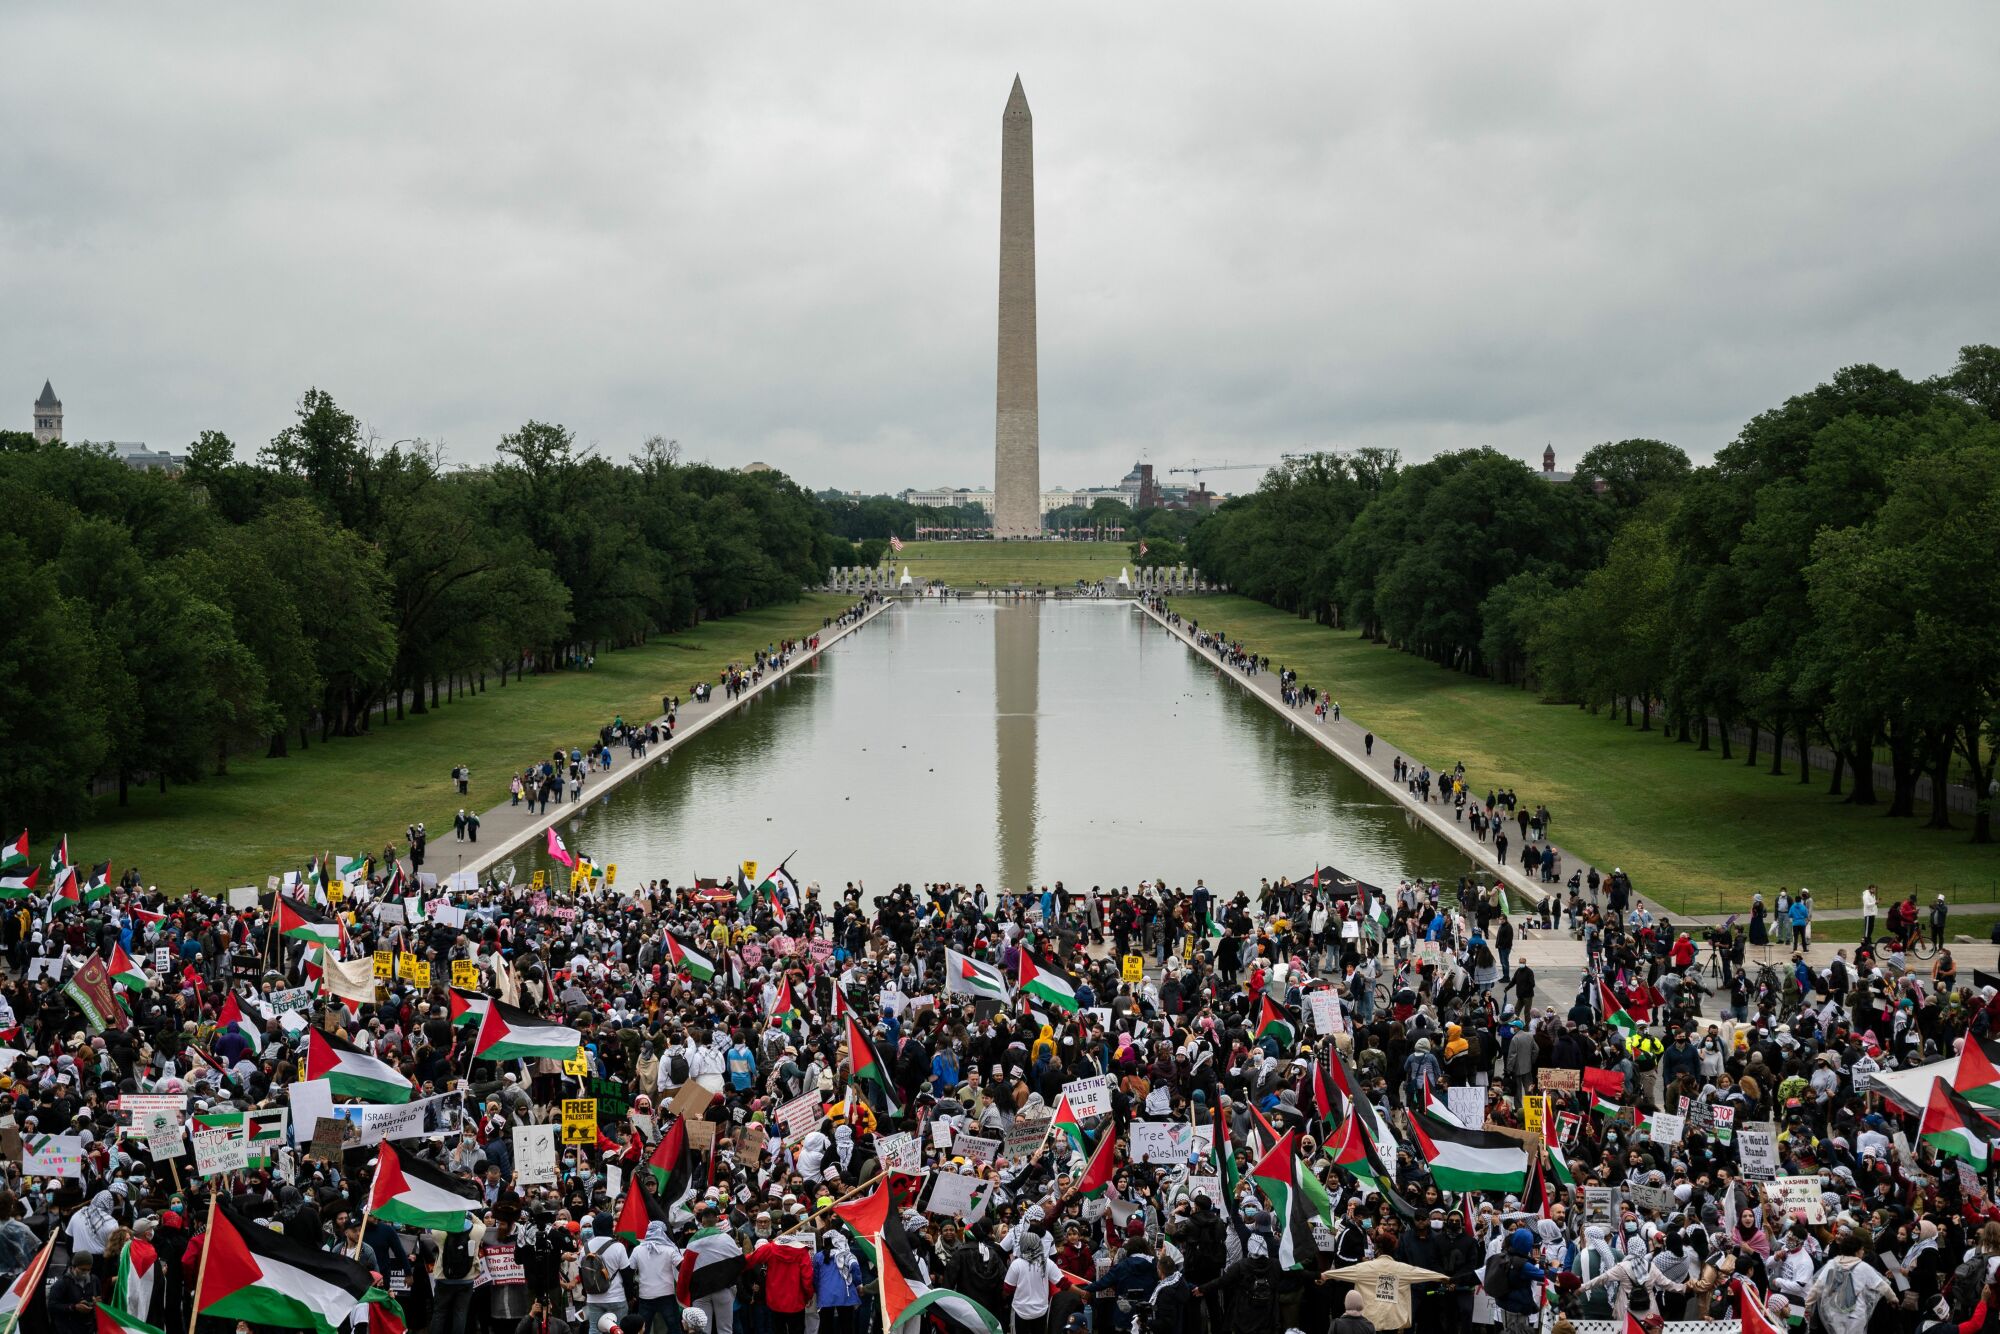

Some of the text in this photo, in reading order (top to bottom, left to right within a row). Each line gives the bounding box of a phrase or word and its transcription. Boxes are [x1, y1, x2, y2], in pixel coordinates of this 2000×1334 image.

[375, 952, 391, 960] FREE
[454, 961, 471, 969] FREE
[1063, 1077, 1106, 1094] PALESTINE
[1069, 1093, 1098, 1105] WILL BE
[565, 1101, 594, 1113] FREE
[1077, 1105, 1097, 1117] FREE
[1713, 1106, 1733, 1120] STOP
[364, 1112, 393, 1122] ISRAEL
[399, 1109, 407, 1118] IS
[370, 1114, 417, 1131] APARTHEID
[1715, 1120, 1733, 1129] ILLING
[381, 1124, 404, 1135] STATE
[1138, 1126, 1166, 1141] Free
[198, 1132, 227, 1149] STOP
[1748, 1135, 1770, 1146] World
[966, 1142, 986, 1152] LIVES
[1147, 1140, 1189, 1159] Palestine
[1744, 1146, 1768, 1157] Stands
[1743, 1163, 1774, 1175] Palestine
[1632, 1184, 1658, 1197] STOP
